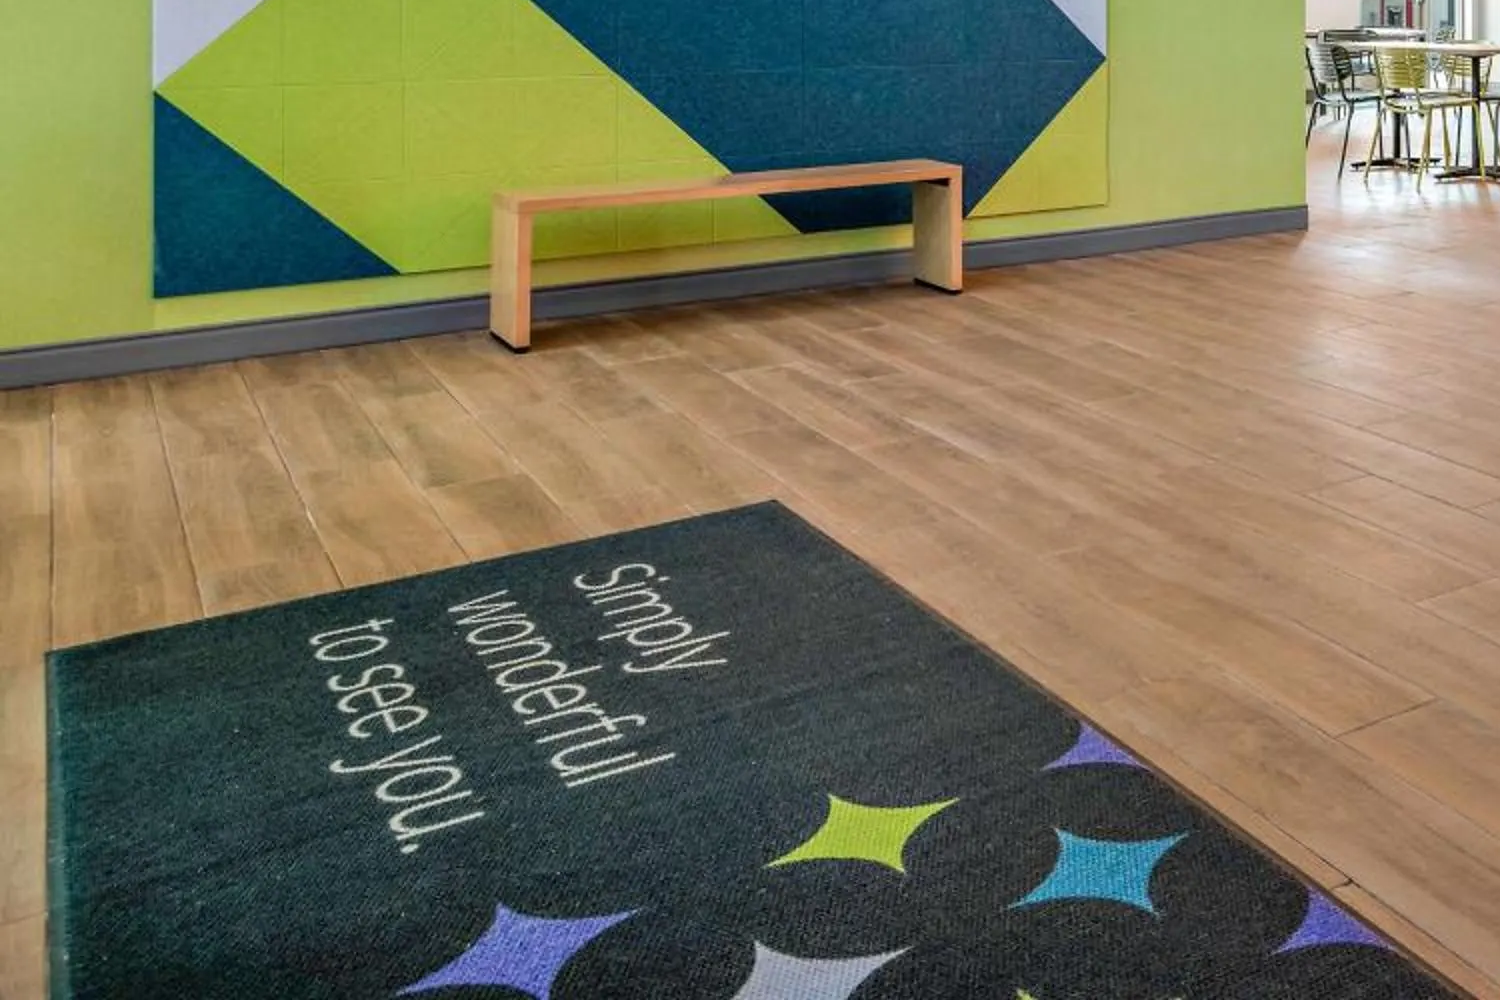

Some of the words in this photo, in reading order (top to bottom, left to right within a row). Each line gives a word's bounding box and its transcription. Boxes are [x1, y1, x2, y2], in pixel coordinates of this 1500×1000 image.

[309, 617, 395, 663] to
[572, 562, 731, 675] simply
[327, 662, 430, 740] see
[447, 589, 677, 789] wonderful
[328, 734, 486, 856] you.
